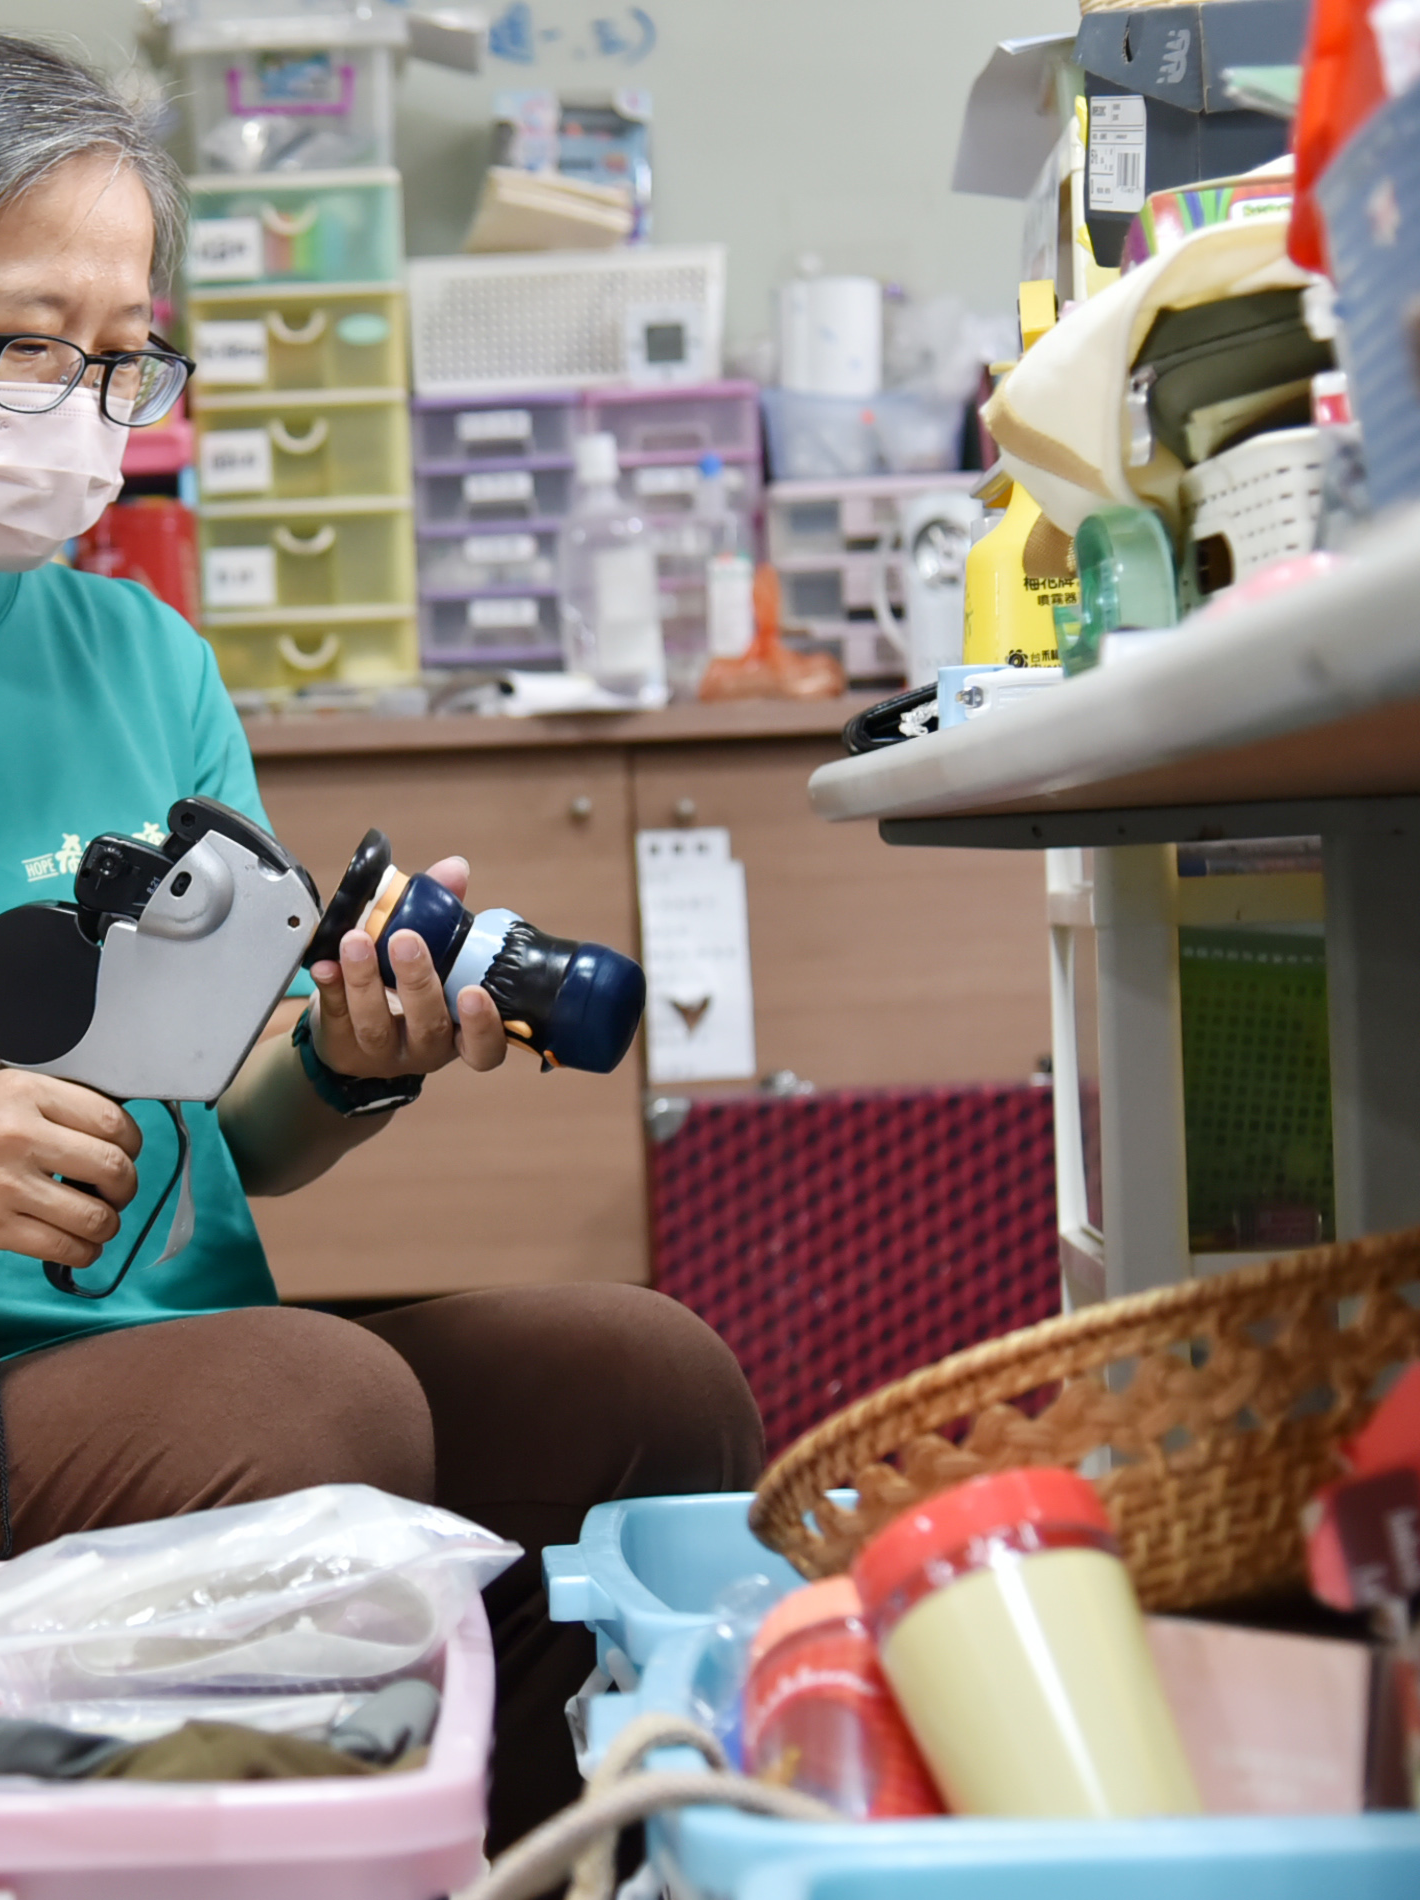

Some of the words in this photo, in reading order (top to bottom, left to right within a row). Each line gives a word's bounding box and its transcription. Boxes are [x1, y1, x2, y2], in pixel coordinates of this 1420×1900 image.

[1037, 591, 1078, 606] 噴霧器
[25, 857, 57, 876] HOPE
